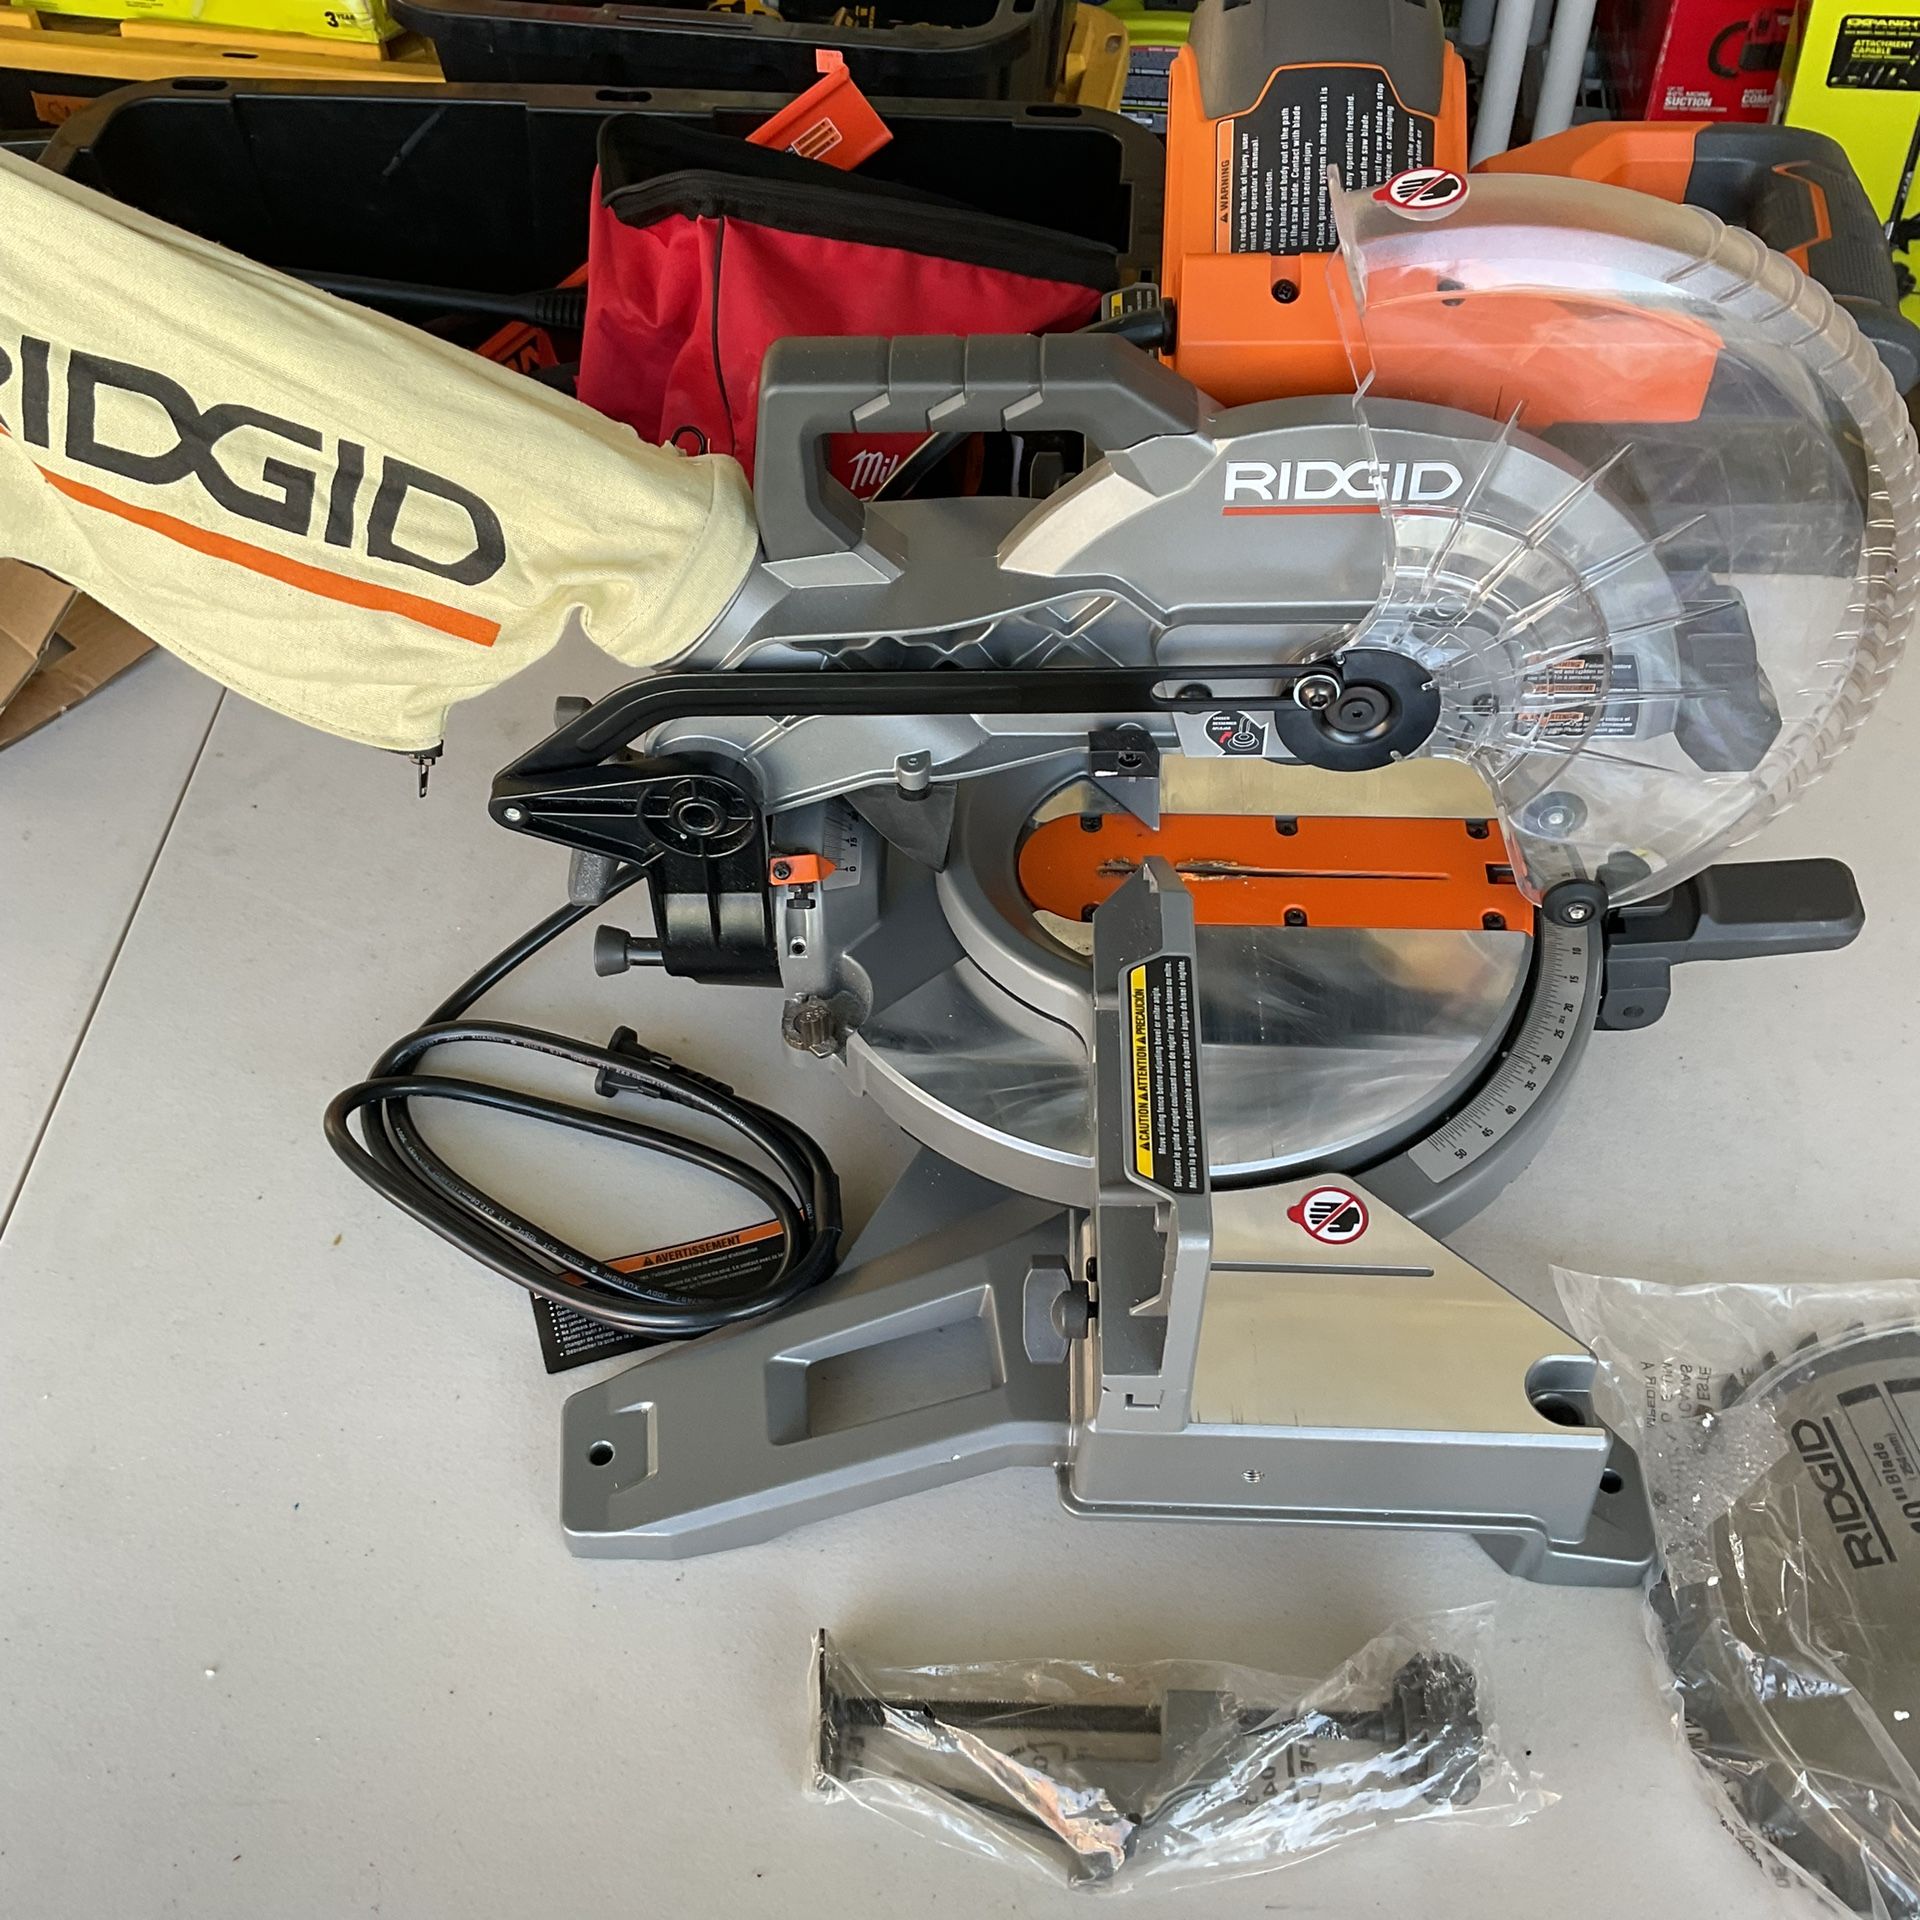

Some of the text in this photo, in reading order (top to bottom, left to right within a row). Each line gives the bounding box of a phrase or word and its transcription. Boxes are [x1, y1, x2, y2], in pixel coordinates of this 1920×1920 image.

[324, 11, 338, 27] 3
[1320, 86, 1328, 94] is
[1376, 83, 1385, 99] stop
[1665, 97, 1712, 107] SUCTION
[1281, 107, 1290, 125] path
[1292, 105, 1300, 128] blade
[1320, 104, 1328, 121] sure
[1361, 112, 1369, 137] blade.
[1375, 112, 1383, 133] blade
[1386, 105, 1394, 149] or changing
[1281, 127, 1289, 140] the
[1292, 130, 1300, 147] with
[1319, 123, 1327, 145] make
[1251, 136, 1259, 169] manual.
[1281, 142, 1288, 150] of
[1319, 146, 1327, 155] to
[1346, 132, 1355, 170] operation
[1241, 150, 1249, 176] injury,
[1291, 148, 1299, 178] Contact
[1319, 156, 1328, 184] system
[1360, 156, 1368, 169] the
[1241, 176, 1248, 184] of
[1280, 166, 1289, 185] body
[1346, 172, 1354, 186] any
[1374, 165, 1382, 182] wait
[1220, 160, 1229, 211] WARNING
[1240, 186, 1248, 200] risk
[1250, 171, 1259, 210] operator's
[1265, 168, 1273, 211] protection.
[1280, 186, 1288, 201] and
[1291, 180, 1299, 205] blade.
[1301, 139, 1313, 246] will result in serious injury.
[1317, 186, 1327, 220] guarding
[1265, 213, 1273, 227] eye
[1279, 203, 1288, 226] hands
[1239, 215, 1247, 241] reduce
[1290, 225, 1298, 237] the
[1316, 222, 1325, 246] Check
[1279, 228, 1287, 248] Keep
[1290, 238, 1297, 246] of
[1239, 243, 1246, 253] To
[848, 450, 899, 490] Mil
[1224, 459, 1463, 502] RIDGID
[850, 837, 858, 847] 15
[1572, 947, 1582, 956] 10
[1569, 975, 1579, 984] 15
[1152, 985, 1161, 1004] angle.
[1165, 986, 1173, 1005] biseau
[1178, 987, 1187, 1001] bisel
[1153, 1005, 1161, 1020] miter
[1563, 1003, 1574, 1012] 20
[1153, 1029, 1162, 1045] bevel
[1553, 1029, 1565, 1039] 25
[1181, 1039, 1191, 1059] ajustar
[1132, 988, 1149, 1141] CAUTION ATTENTION PRECAUCIÓN
[1154, 1046, 1164, 1074] adjusting
[1168, 1060, 1177, 1076] avant
[1183, 1061, 1191, 1069] de
[1541, 1054, 1552, 1065] 30
[1155, 1075, 1164, 1095] before
[1183, 1070, 1192, 1086] antes
[1524, 1080, 1537, 1091] 35
[1169, 1078, 1179, 1107] coulissant
[1156, 1096, 1165, 1112] fence
[1184, 1088, 1194, 1119] deslizable
[1504, 1104, 1517, 1115] 40
[1157, 1114, 1166, 1135] sliding
[1186, 1120, 1196, 1146] ingletes
[1481, 1127, 1494, 1137] 45
[1158, 1137, 1166, 1154] Move
[1171, 1133, 1182, 1151] guide
[1454, 1148, 1467, 1159] 50
[1189, 1167, 1197, 1188] Mueva
[656, 1235, 741, 1263] AVERTISSEMENT
[569, 1323, 588, 1334] jamais
[1873, 1441, 1904, 1485] Blade
[1791, 1418, 1884, 1569] RIDGID
